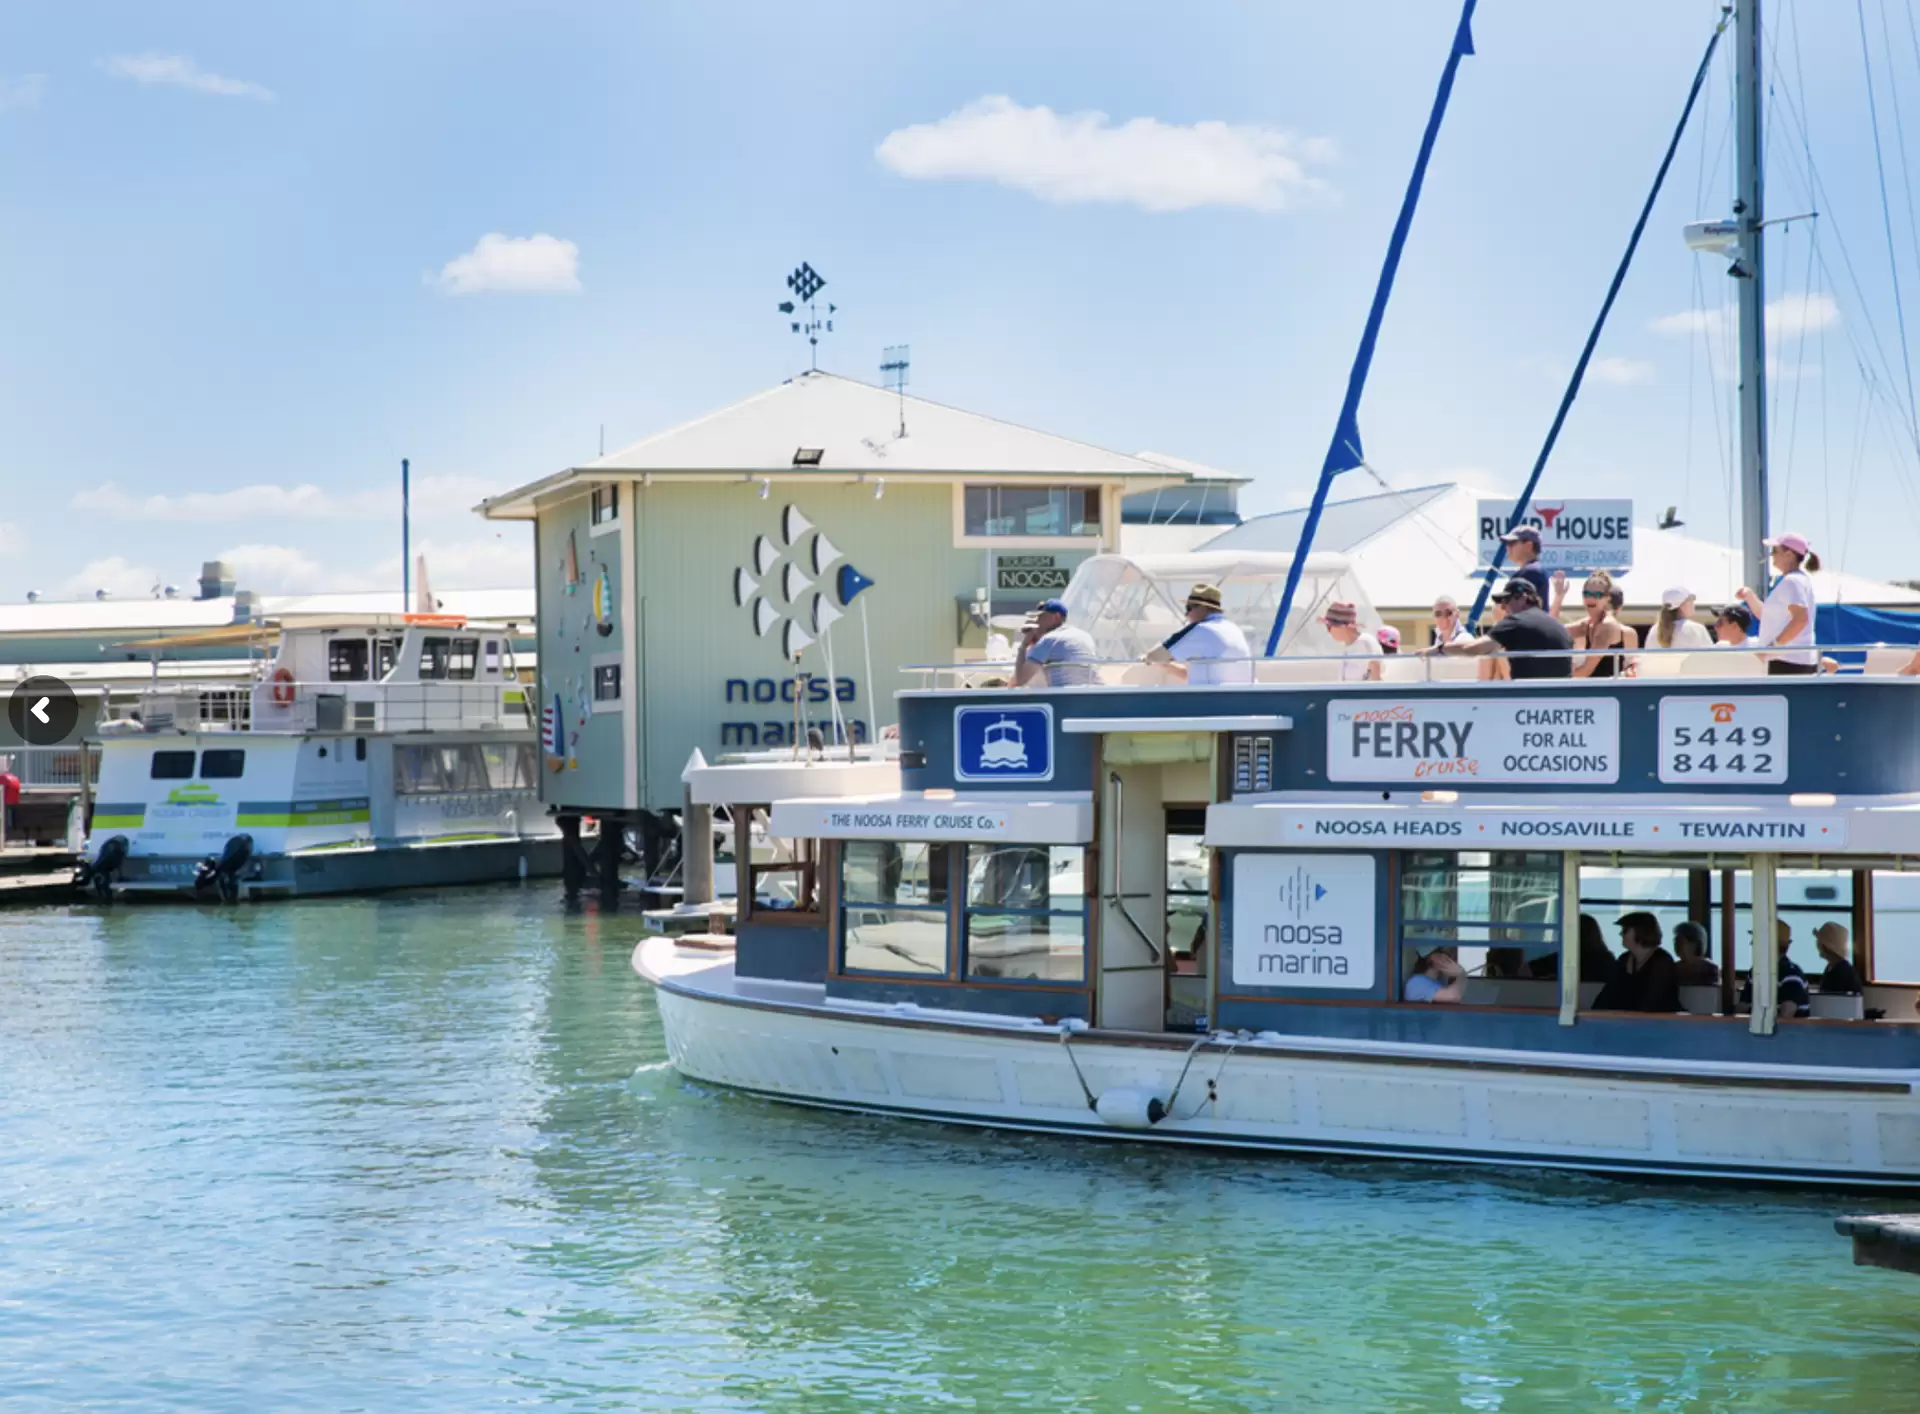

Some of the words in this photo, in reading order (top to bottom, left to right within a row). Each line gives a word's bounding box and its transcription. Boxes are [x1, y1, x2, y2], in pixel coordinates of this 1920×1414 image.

[1556, 517, 1629, 539] HOUSE
[1001, 571, 1067, 587] NOOSA
[726, 677, 857, 703] noosa
[1353, 705, 1413, 723] noosa
[1515, 708, 1595, 725] CHARTER
[1352, 721, 1474, 758] FERRY
[1523, 732, 1554, 748] FOR
[1558, 732, 1587, 748] ALL
[1414, 754, 1480, 778] cruise
[1503, 754, 1608, 772] OCCASIONS
[832, 814, 850, 827] THE
[854, 814, 892, 828] NOOSA
[896, 814, 930, 828] FERRY
[934, 815, 973, 829] CRUISE
[977, 815, 996, 829] Co.
[1315, 820, 1387, 835] NOOSA
[1393, 820, 1462, 836] HEADS
[1501, 821, 1634, 837] NOOSAVILLE
[1679, 822, 1806, 838] TEWANTIN
[1264, 924, 1343, 945] noosa
[1258, 948, 1348, 976] marina
